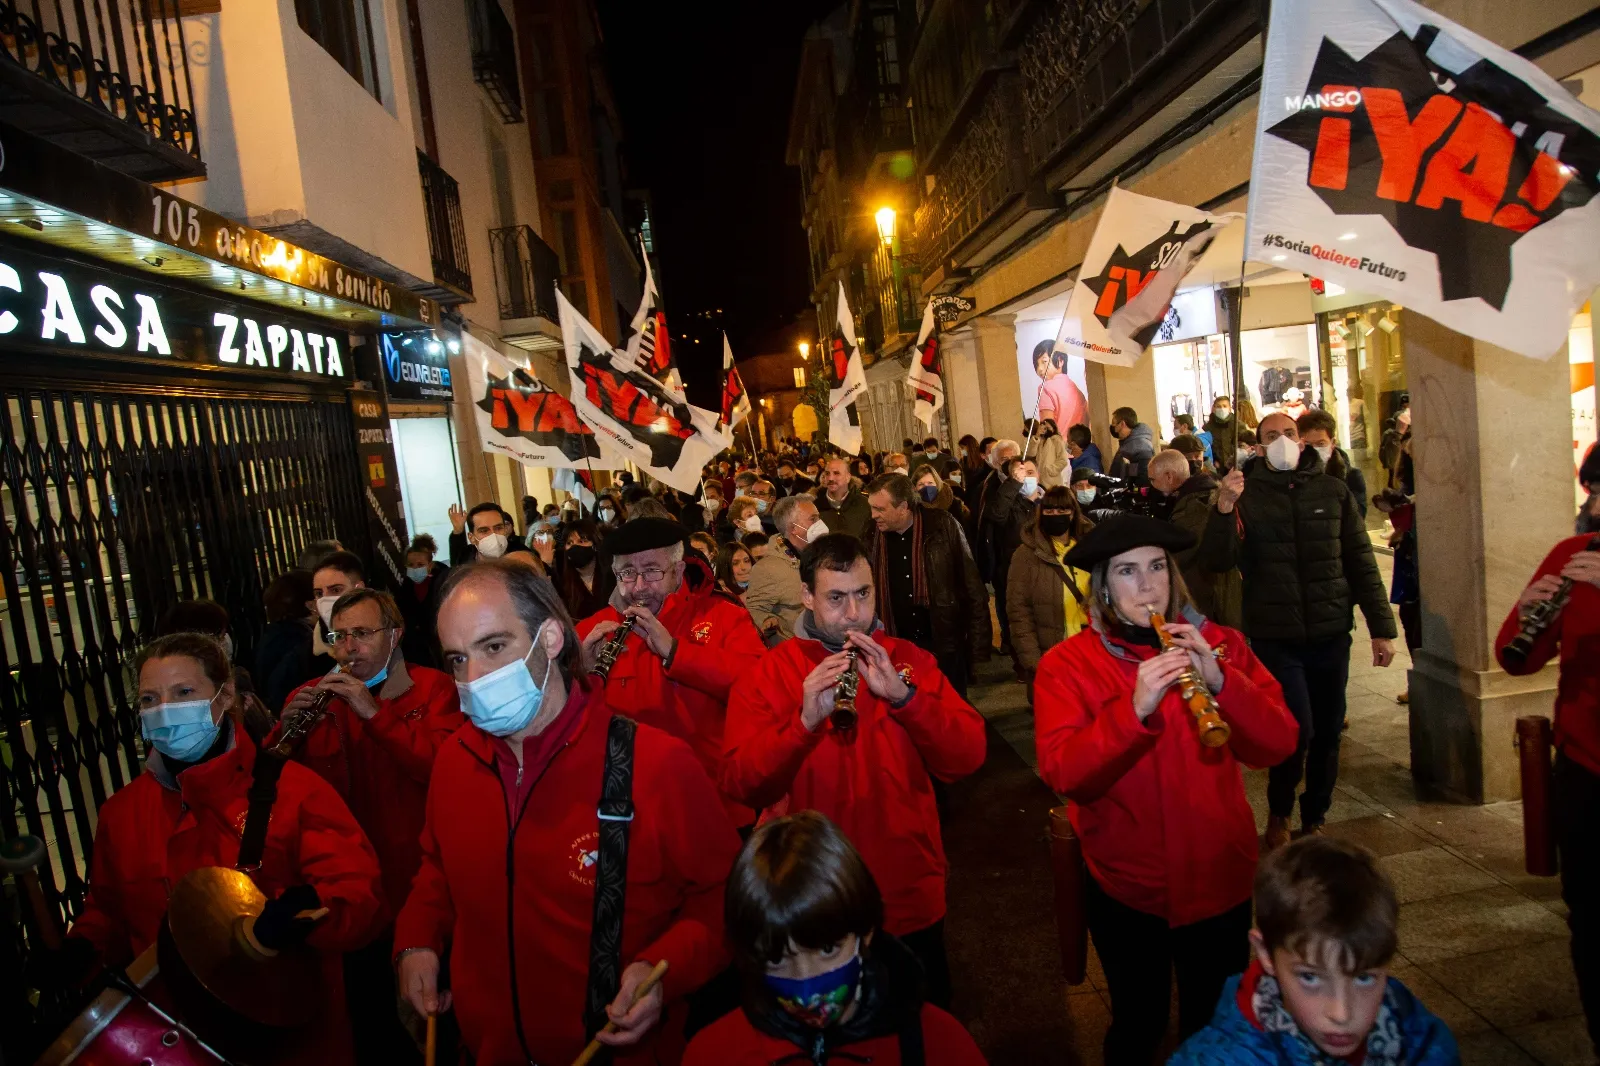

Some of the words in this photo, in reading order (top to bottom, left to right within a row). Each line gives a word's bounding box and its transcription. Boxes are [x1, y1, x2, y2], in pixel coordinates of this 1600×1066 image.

[1285, 90, 1361, 111] MANGO
[152, 195, 200, 247] 105
[216, 227, 271, 269] año
[1263, 233, 1408, 282] #SoriaQuiereFuturo
[0, 263, 172, 355] CASA
[213, 312, 345, 378] ZAPATA
